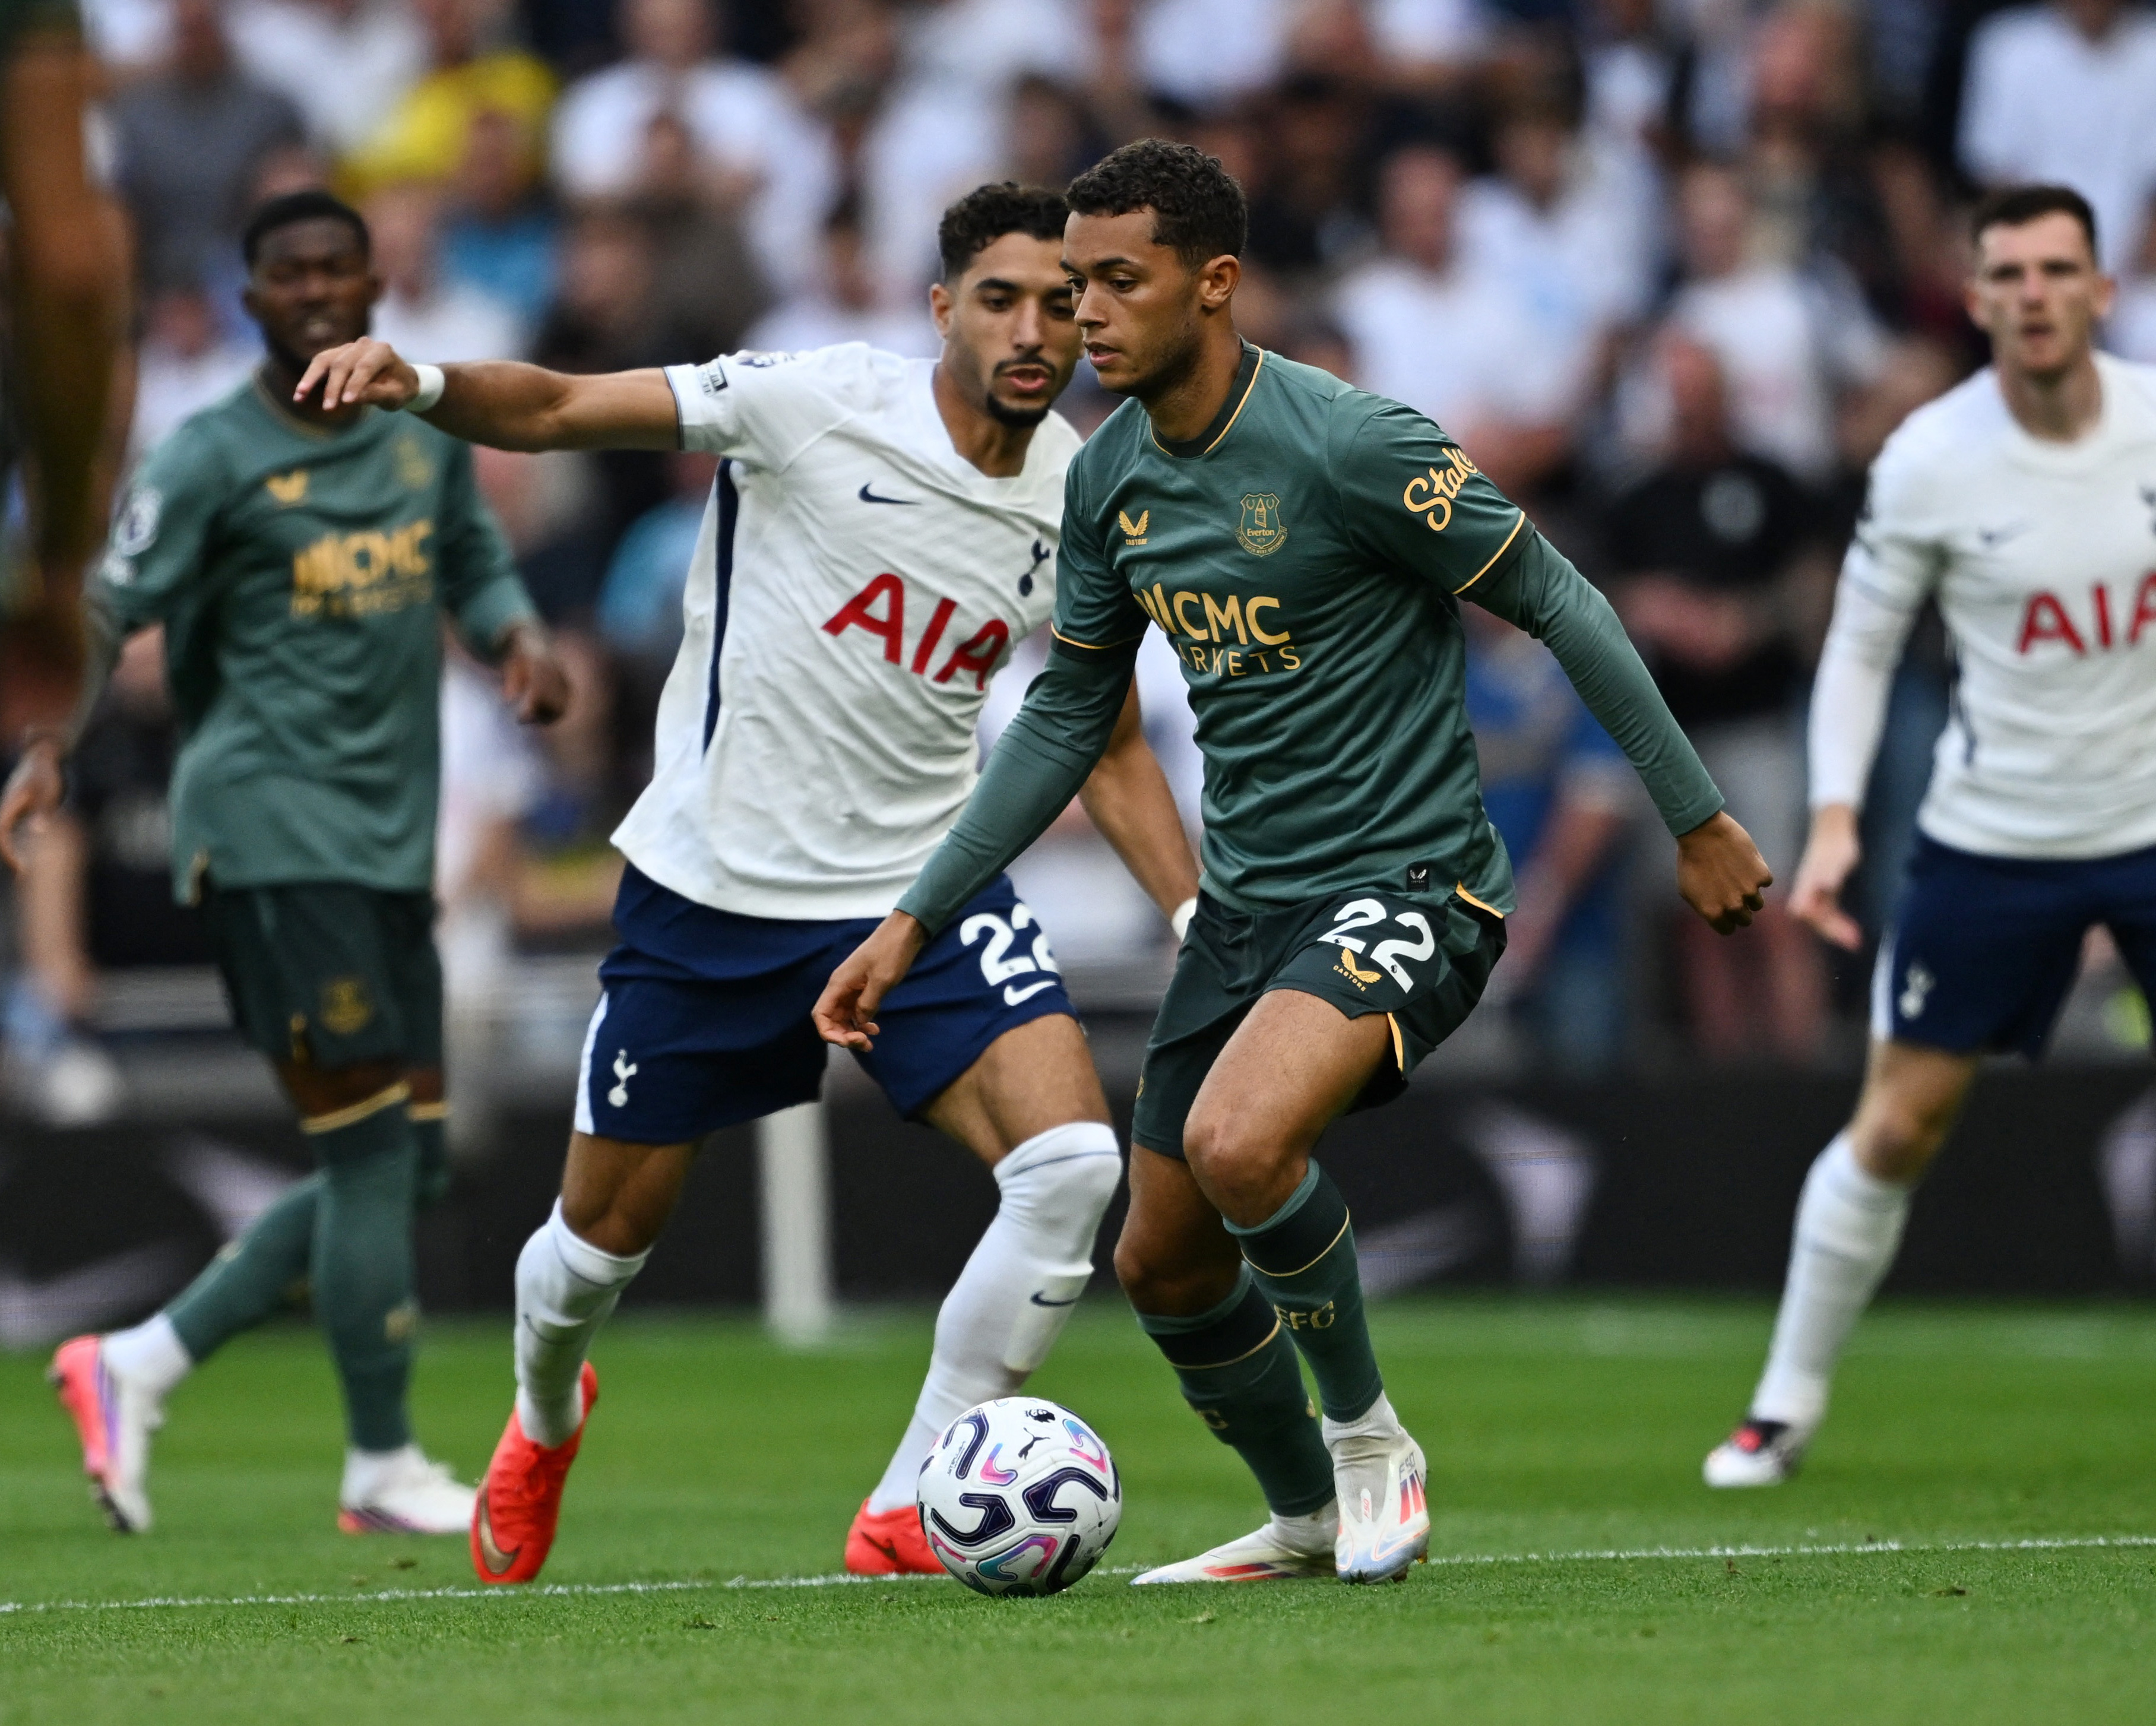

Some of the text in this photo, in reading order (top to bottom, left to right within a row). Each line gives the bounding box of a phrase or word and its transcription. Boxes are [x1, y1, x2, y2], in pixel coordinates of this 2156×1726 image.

[1247, 528, 1275, 537] Everton
[821, 573, 1009, 691] AIA
[1177, 642, 1301, 676] ARKETS
[1316, 898, 1435, 994] 22
[1273, 1300, 1334, 1330] EFC
[1399, 1452, 1416, 1481] F50
